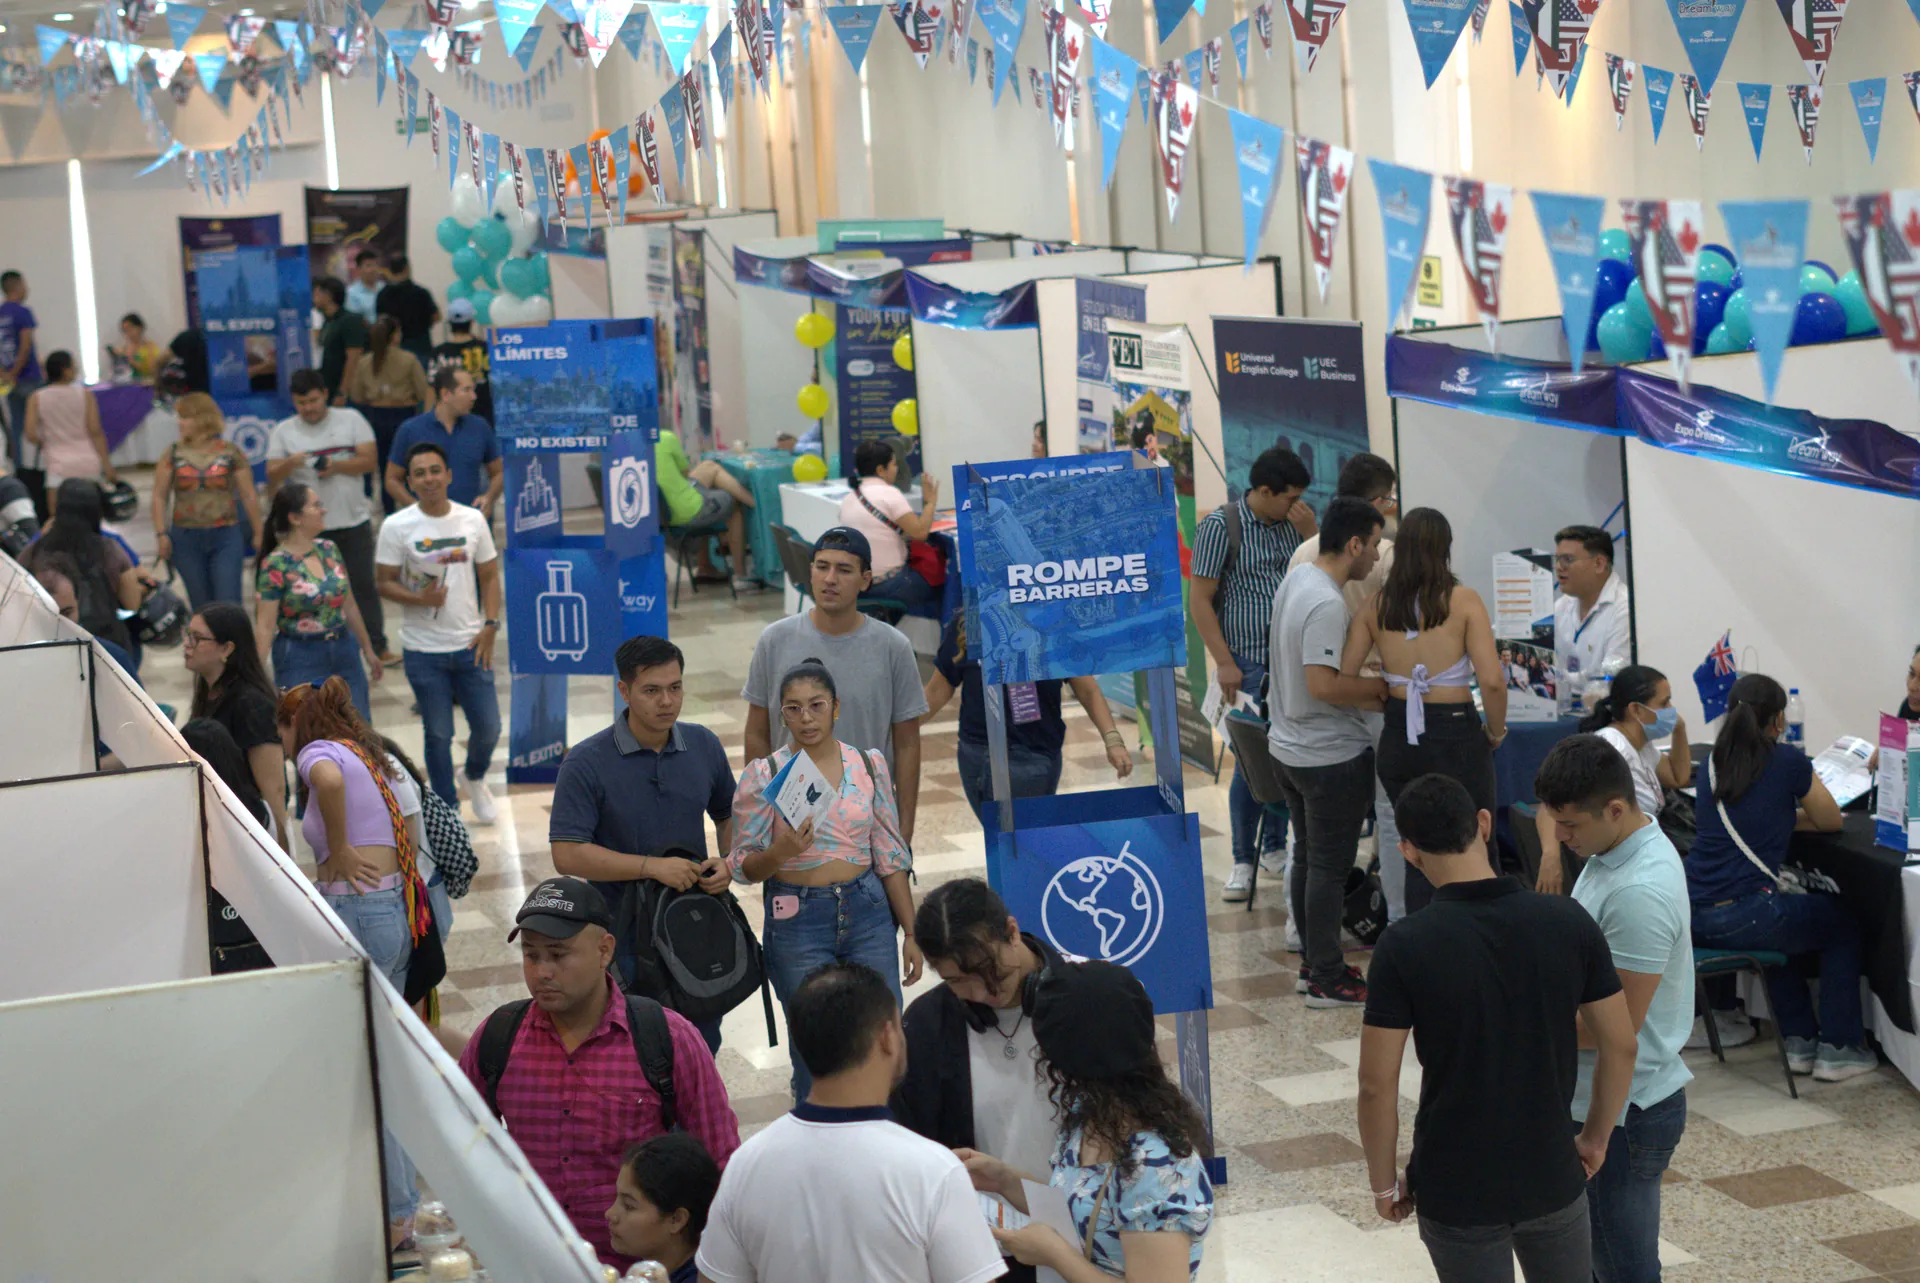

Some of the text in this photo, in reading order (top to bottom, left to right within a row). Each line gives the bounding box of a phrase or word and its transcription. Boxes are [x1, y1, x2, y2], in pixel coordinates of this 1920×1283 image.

[1680, 2, 1737, 14] Dream way
[206, 318, 227, 332] EL
[494, 345, 569, 361] LÍMITES
[1240, 351, 1275, 364] Universal
[1319, 357, 1338, 368] UEC
[1241, 364, 1299, 379] English College
[1320, 369, 1357, 382] Business
[611, 414, 639, 428] DE
[1674, 422, 1726, 444] Expo Dreams
[515, 436, 540, 449] NO
[1787, 435, 1843, 469] Dream way
[1007, 553, 1147, 587] ROMPE
[1009, 577, 1150, 604] BARRERAS
[622, 595, 656, 612] way
[523, 898, 575, 912] LACOSTE
